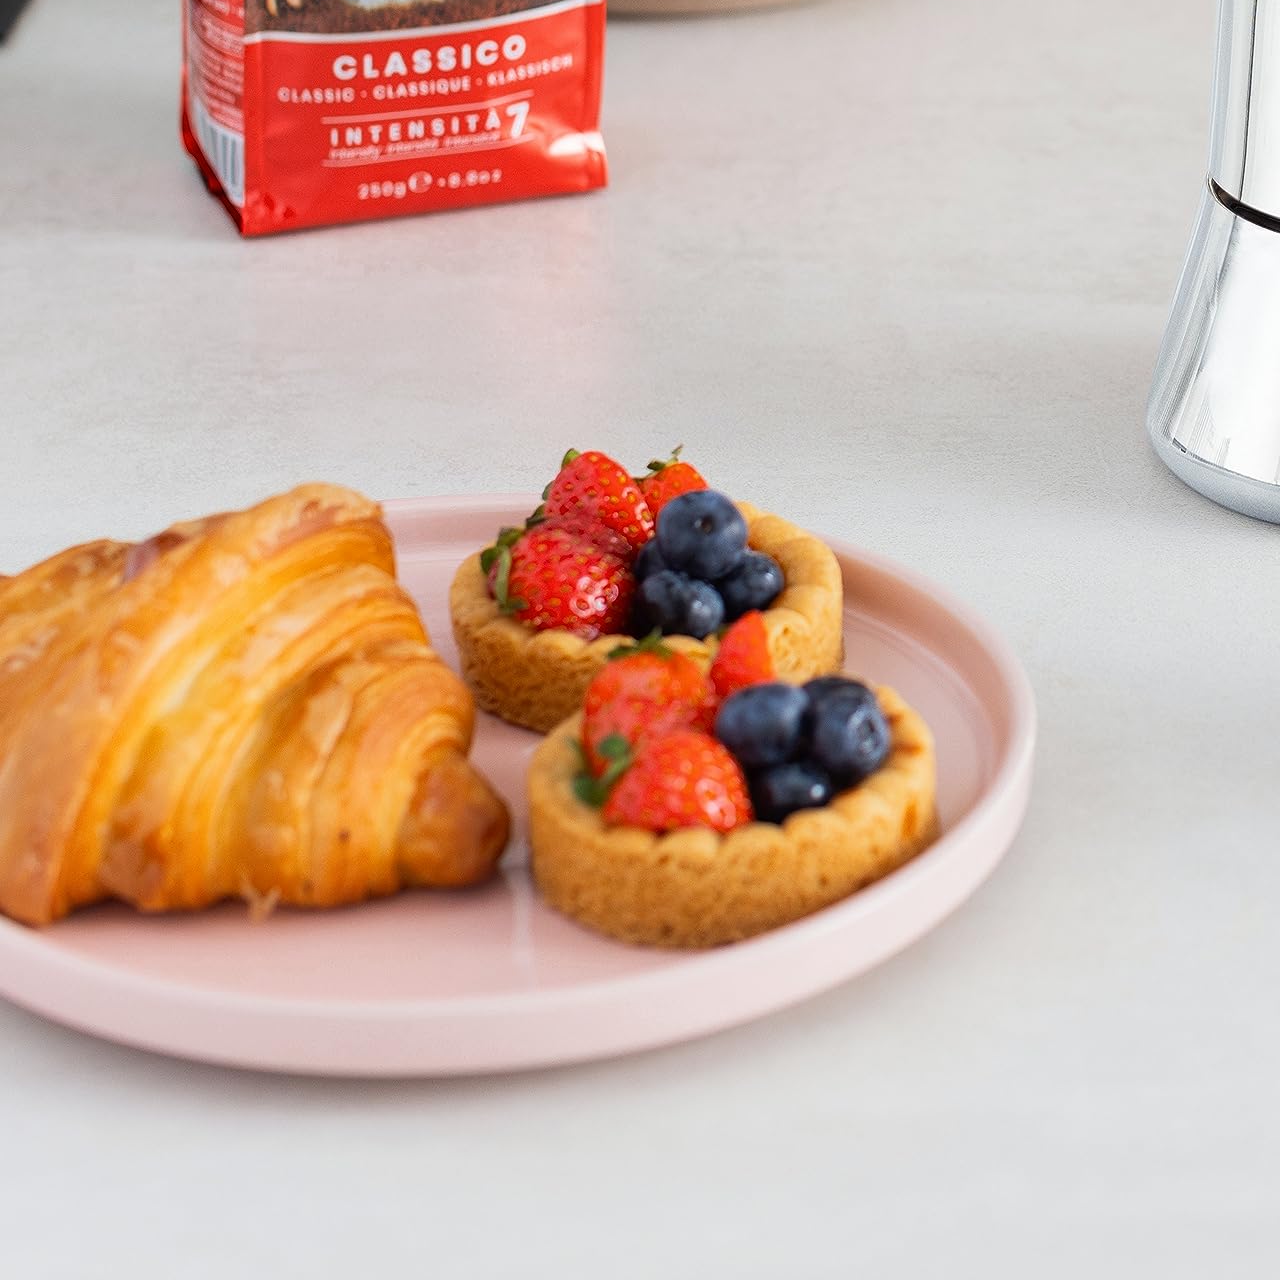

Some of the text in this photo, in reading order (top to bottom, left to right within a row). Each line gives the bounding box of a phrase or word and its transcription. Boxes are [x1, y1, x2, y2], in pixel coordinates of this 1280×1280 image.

[276, 53, 574, 104] CLASSIC CLASSIQUE KLASSISCH
[332, 34, 527, 81] CLASSICO
[506, 101, 530, 139] 7
